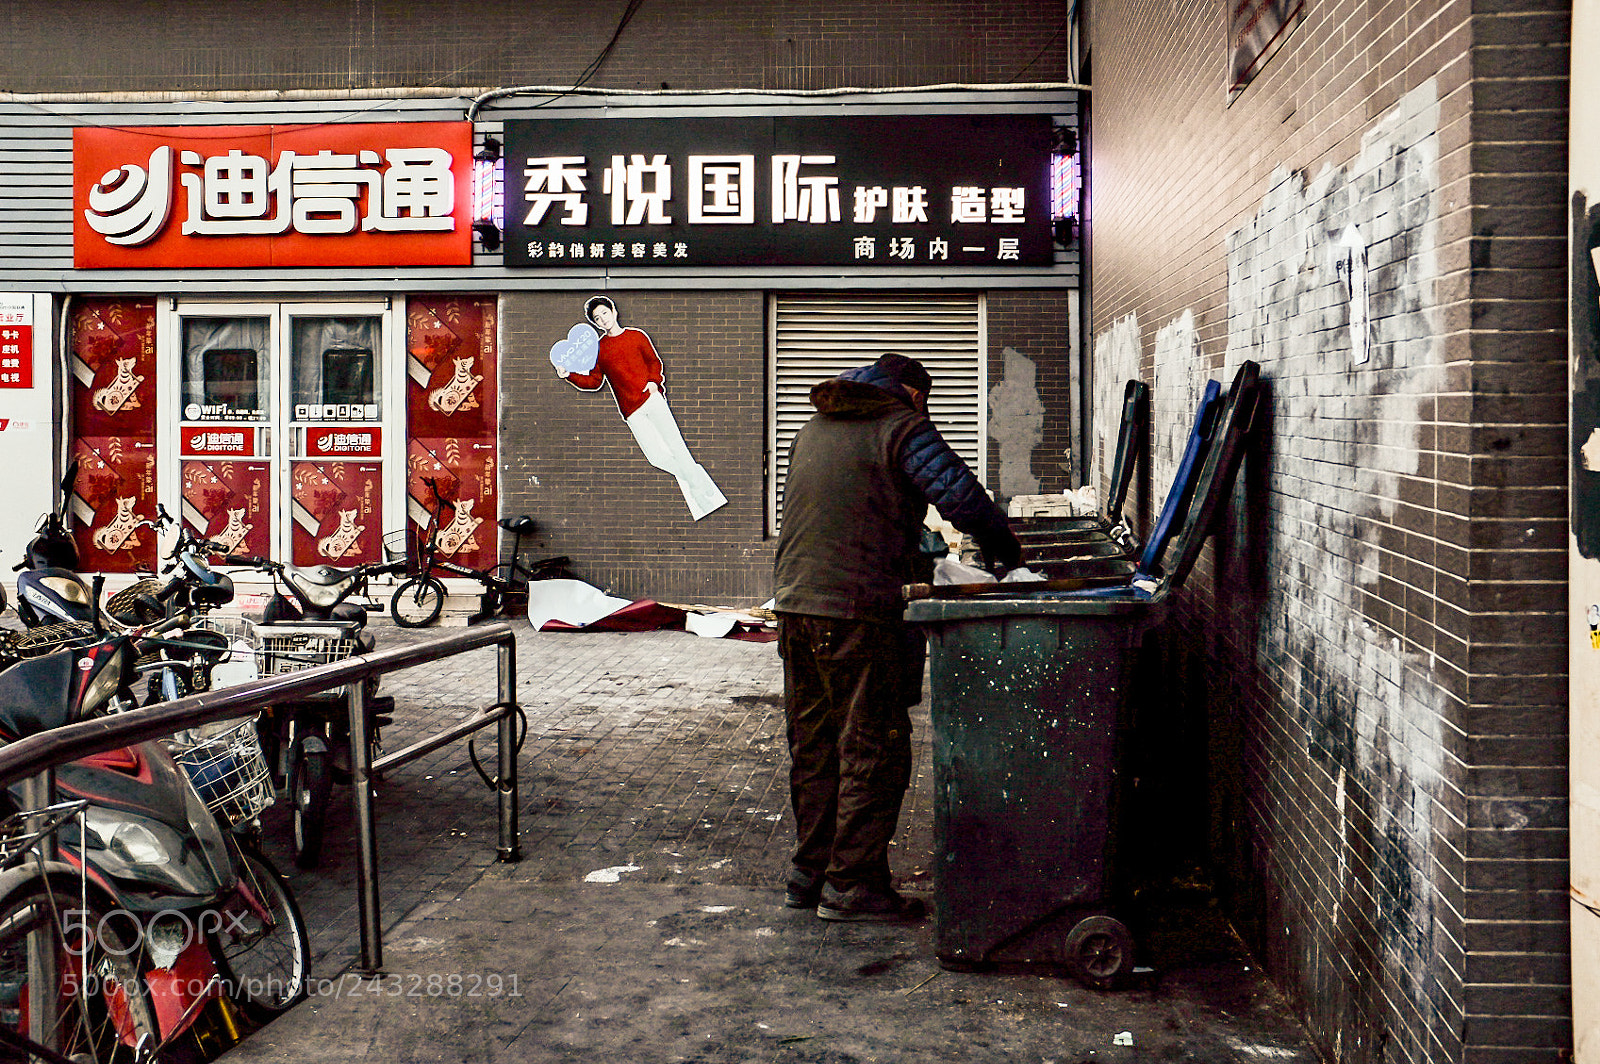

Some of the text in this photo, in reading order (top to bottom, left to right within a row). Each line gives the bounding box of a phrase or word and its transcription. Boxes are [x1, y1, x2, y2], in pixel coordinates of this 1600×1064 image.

[180, 147, 454, 236] 迪信通
[523, 154, 841, 226] 秀悦国际
[853, 185, 1026, 224] 护肤 造型
[853, 236, 1020, 261] 商场内一层
[207, 432, 244, 444] 迪信通
[334, 433, 372, 445] 迪信通
